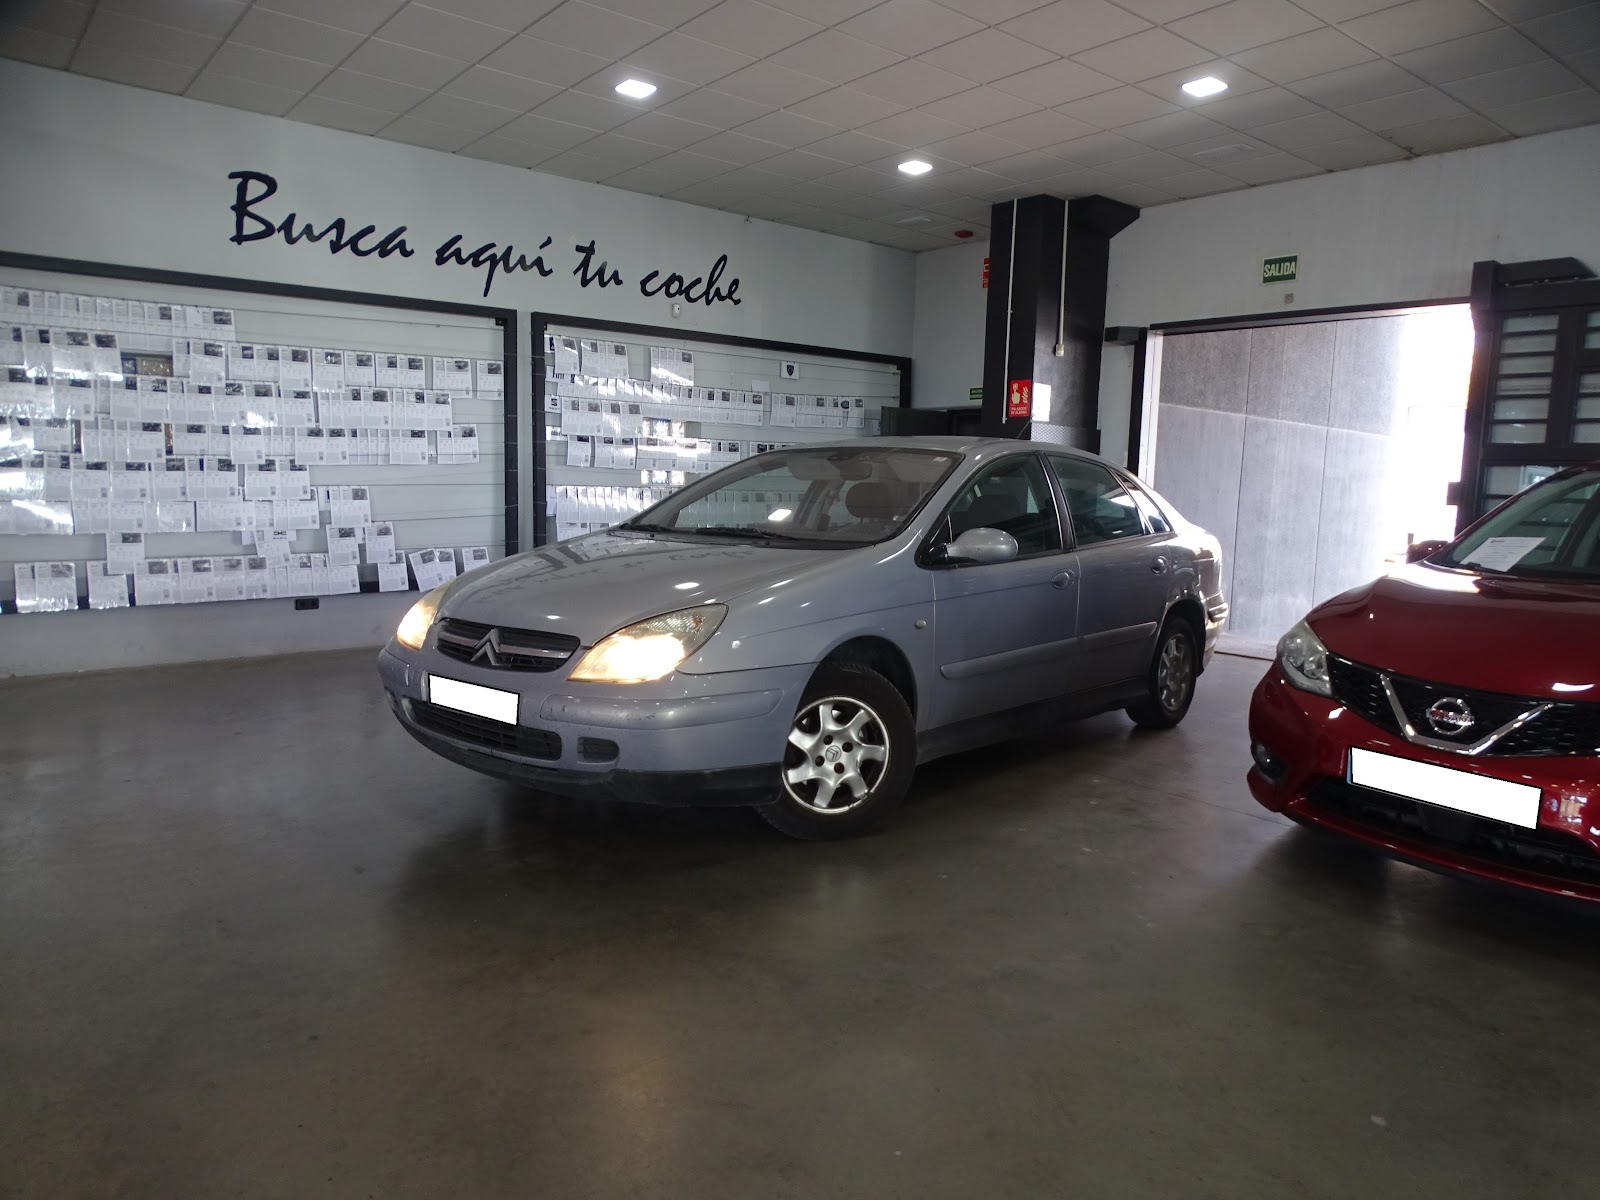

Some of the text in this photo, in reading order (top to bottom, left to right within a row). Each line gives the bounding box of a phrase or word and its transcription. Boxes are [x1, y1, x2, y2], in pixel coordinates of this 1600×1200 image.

[228, 170, 742, 306] Busca aquí tu coche
[1264, 261, 1296, 278] SALIDA
